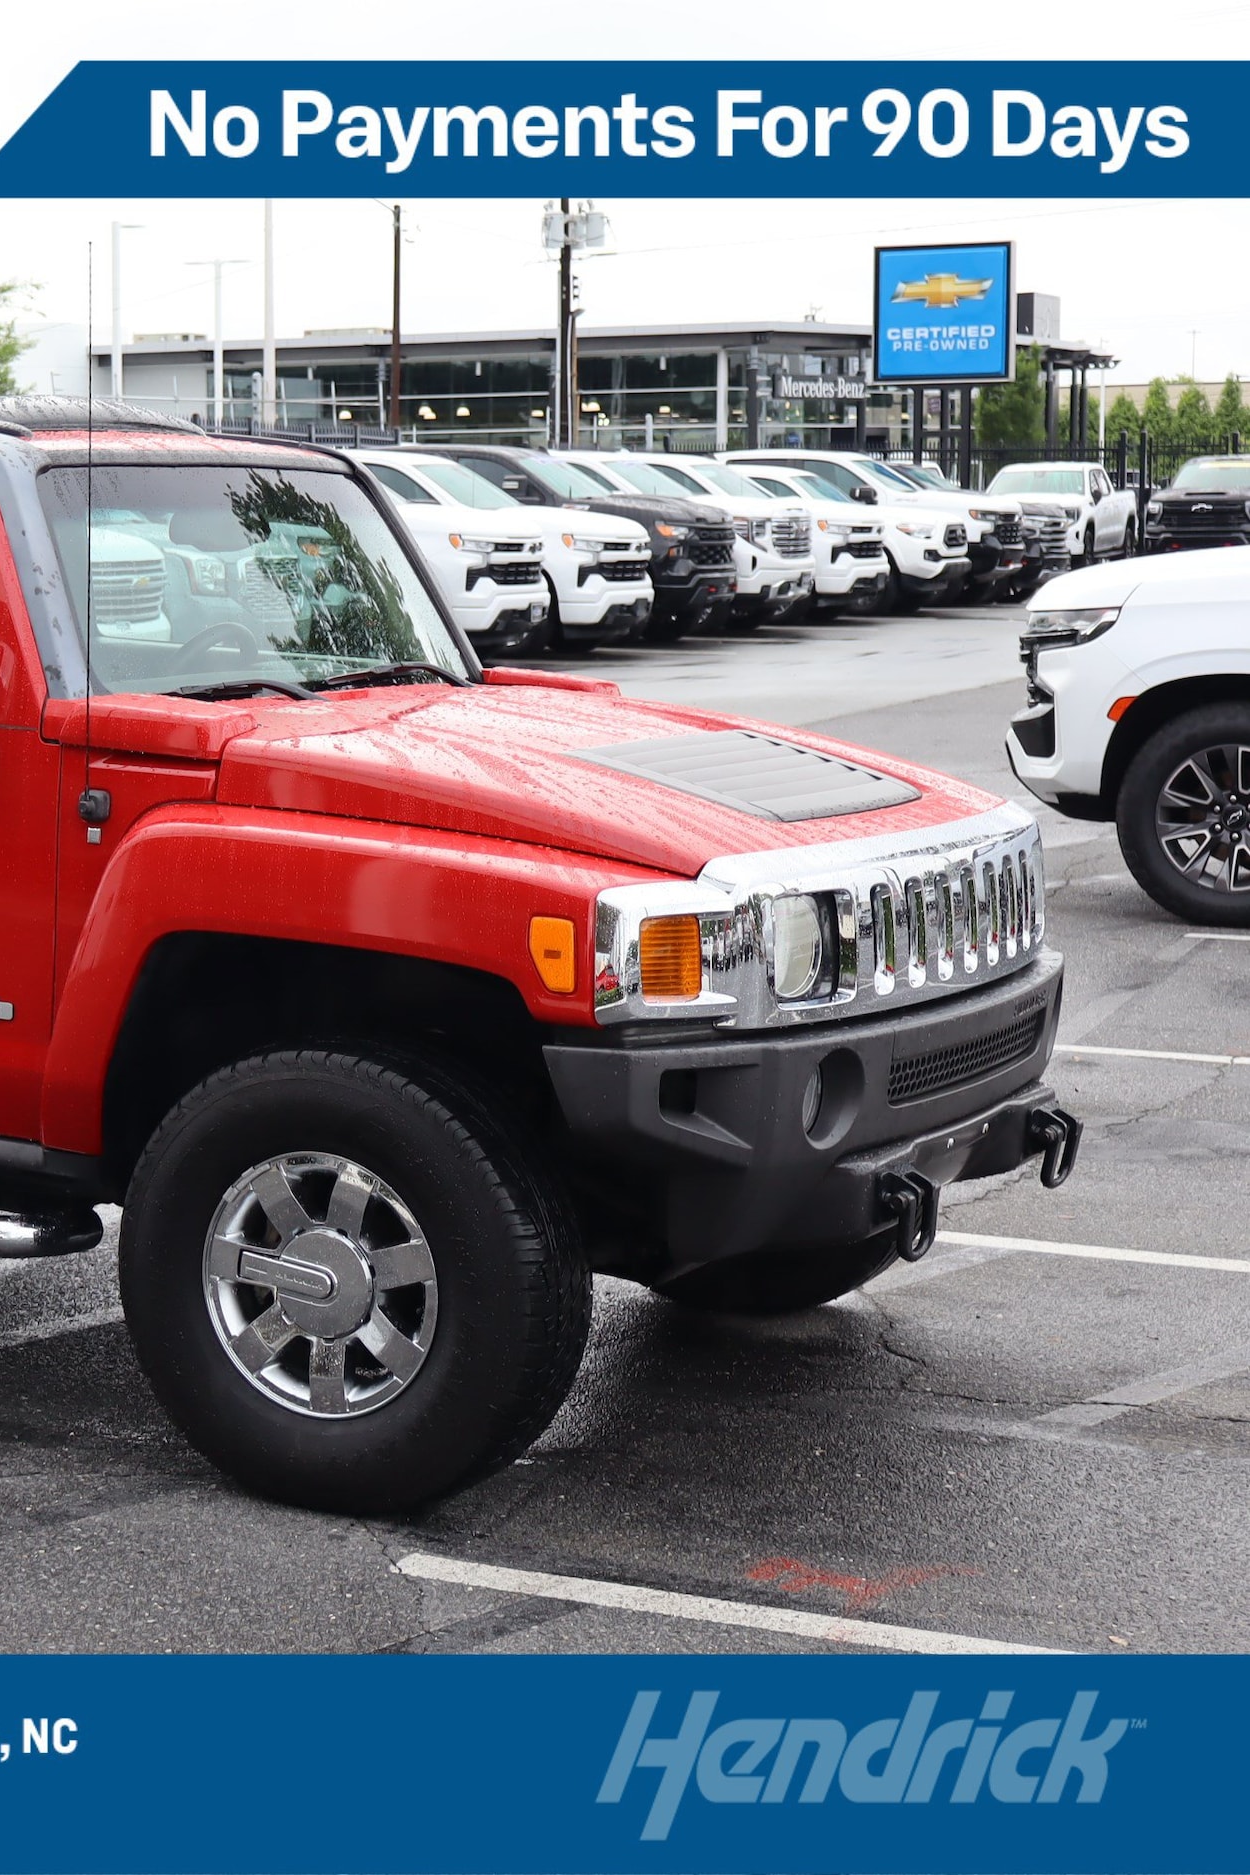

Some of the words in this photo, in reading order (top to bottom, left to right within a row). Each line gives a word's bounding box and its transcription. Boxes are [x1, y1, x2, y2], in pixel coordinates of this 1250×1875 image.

[886, 323, 997, 341] CERTIFIED
[892, 337, 990, 353] PRE-OWNED
[780, 375, 865, 399] Mercedes-Benz
